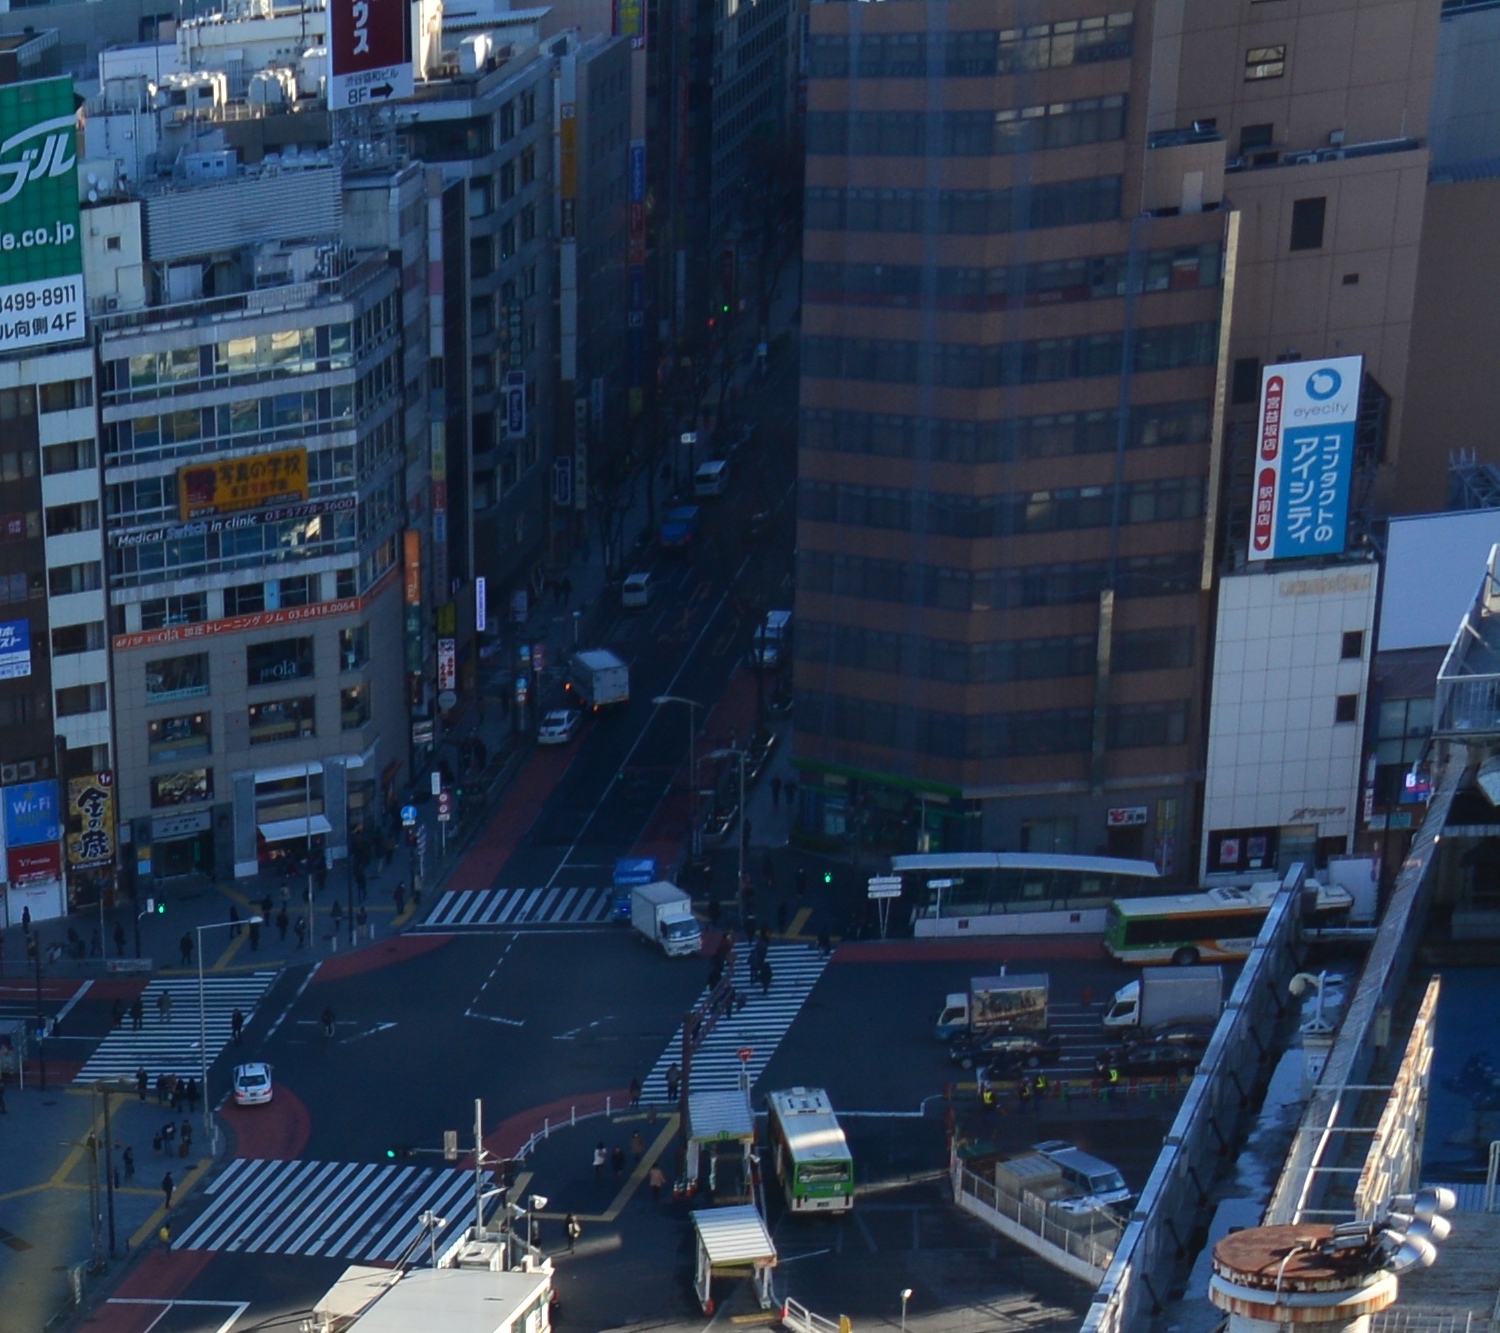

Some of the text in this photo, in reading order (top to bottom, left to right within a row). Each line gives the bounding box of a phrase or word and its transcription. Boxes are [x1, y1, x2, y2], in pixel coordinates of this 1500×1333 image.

[348, 87, 368, 105] 8F
[52, 311, 76, 332] 4F
[1263, 396, 1280, 451] 宮益坂店
[1294, 402, 1349, 421] eyecity
[1257, 486, 1274, 526] 駅前店
[1288, 436, 1319, 544] アイシティ
[1315, 434, 1341, 542] コンタクトの
[118, 530, 163, 547] Medical
[225, 513, 258, 531] clinic
[13, 796, 51, 815] Wi-Fi
[78, 787, 110, 859] 金の蔵
